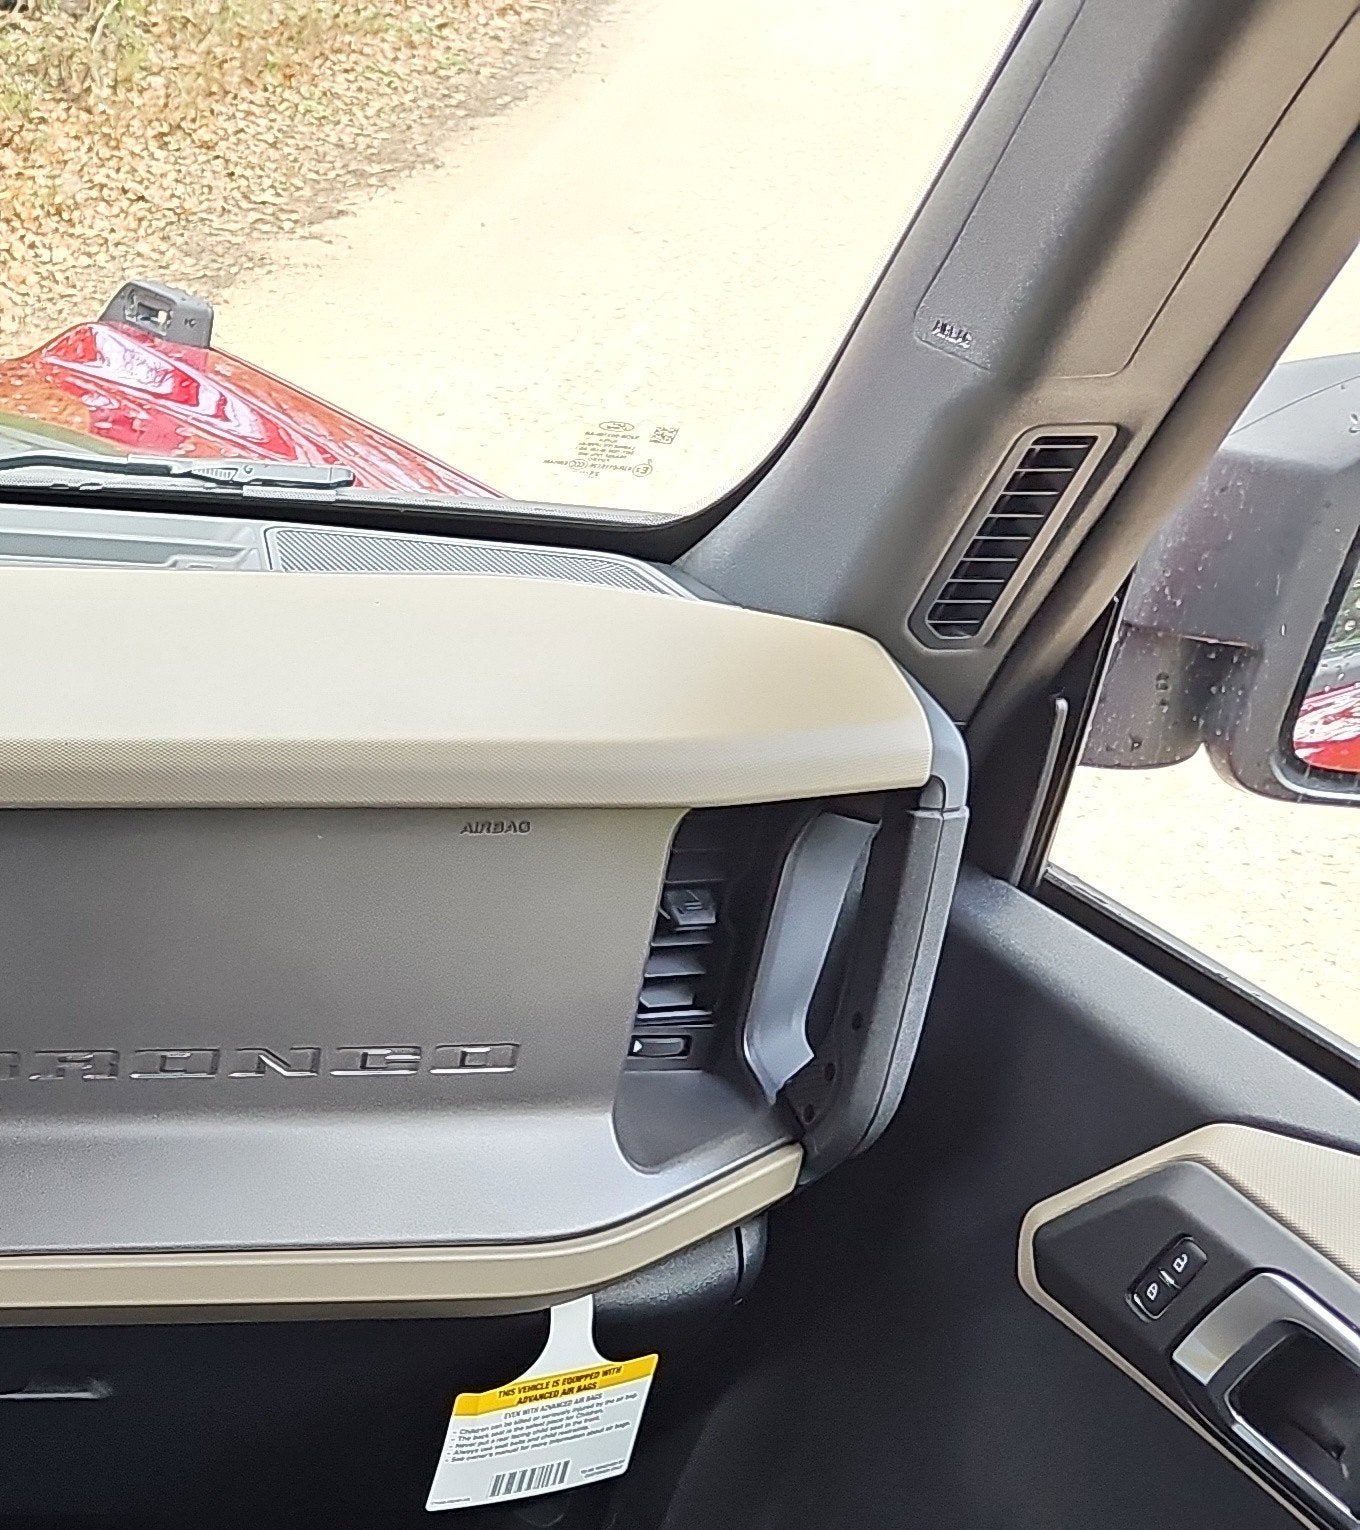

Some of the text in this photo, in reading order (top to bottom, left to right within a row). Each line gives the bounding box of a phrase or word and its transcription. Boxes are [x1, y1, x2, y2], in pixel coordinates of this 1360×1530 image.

[459, 820, 531, 835] AIRBAG
[498, 1365, 621, 1397] THIS VEHICLE IS EQUIPPED WITH
[516, 1381, 596, 1404] ADVANCED AIR BAGS
[503, 1392, 602, 1419] EVEN WITH ADVANCED AIR BAGS
